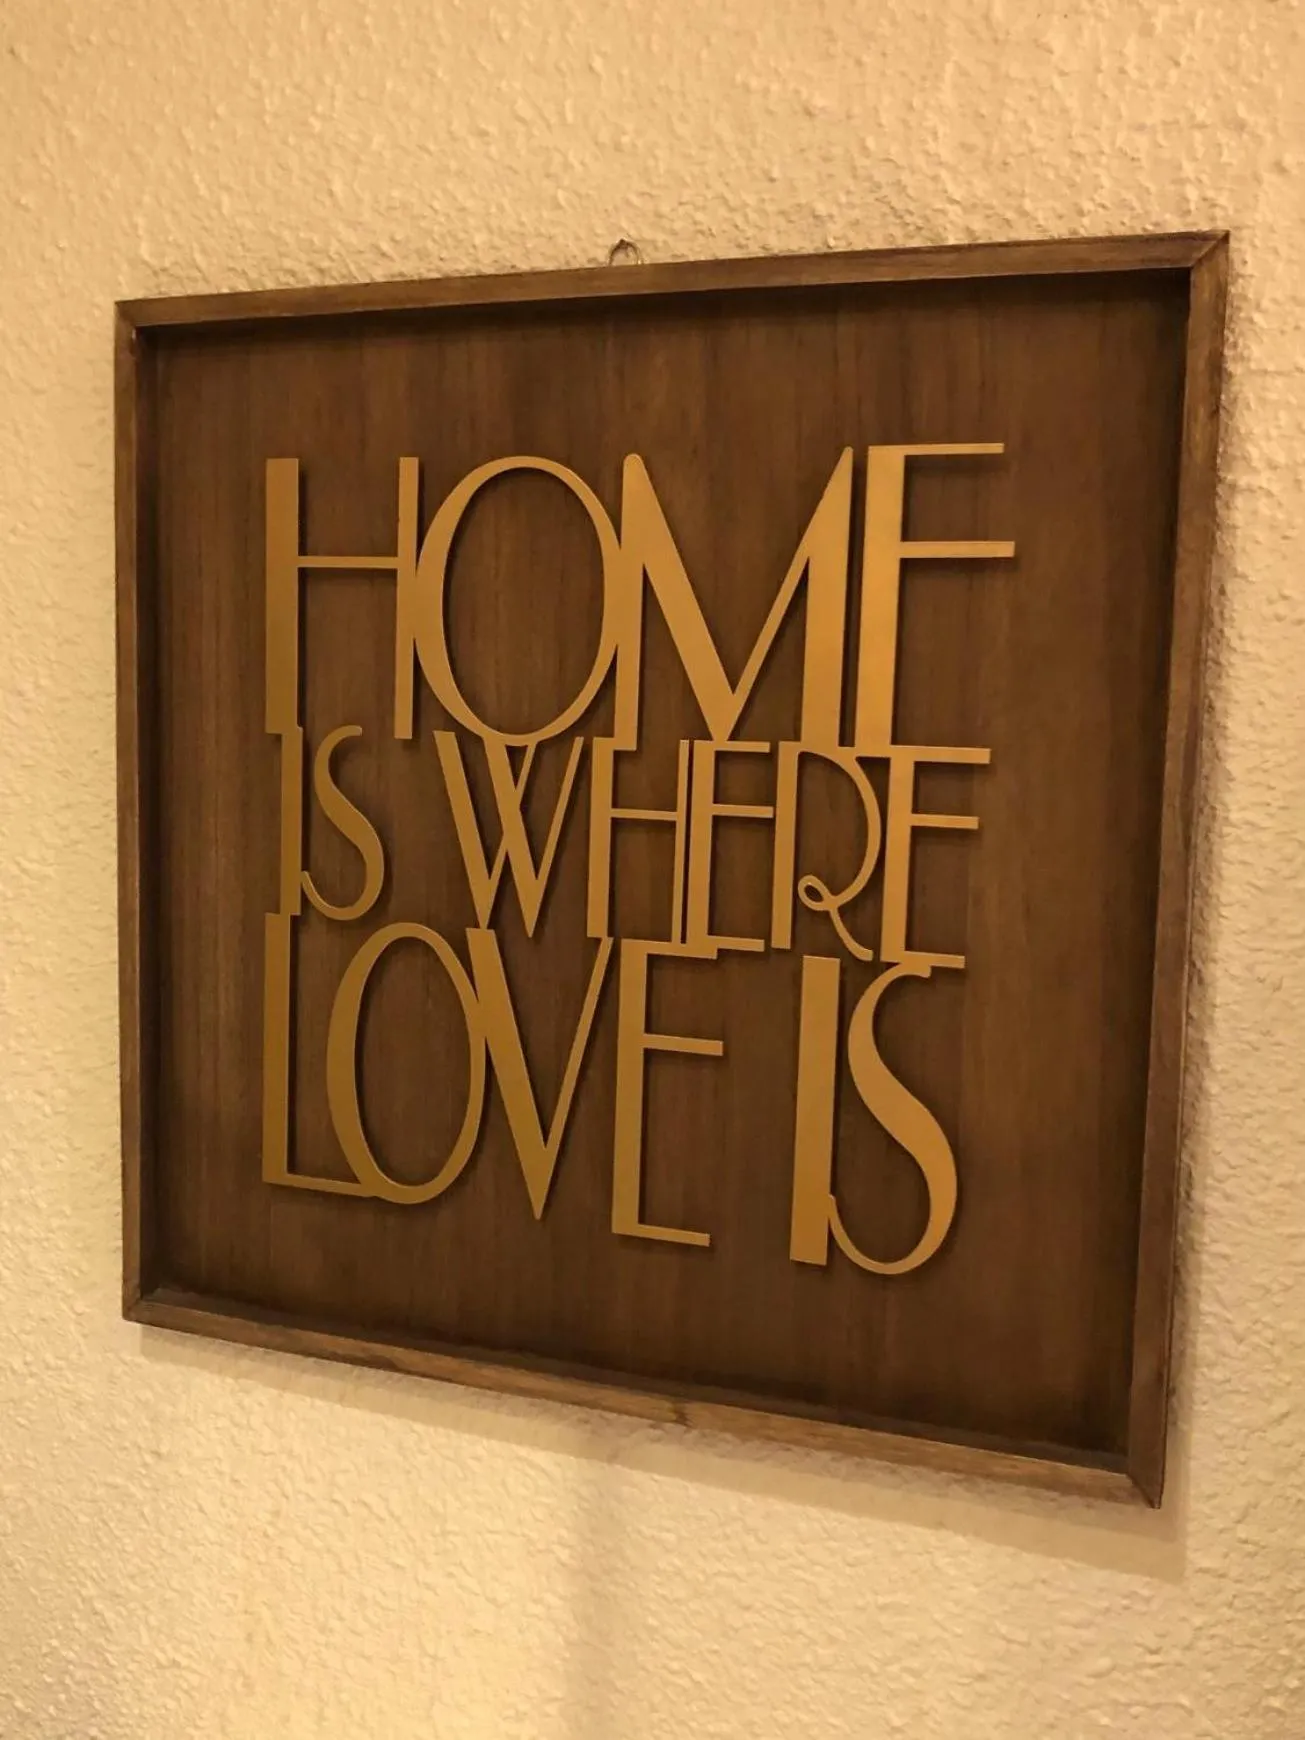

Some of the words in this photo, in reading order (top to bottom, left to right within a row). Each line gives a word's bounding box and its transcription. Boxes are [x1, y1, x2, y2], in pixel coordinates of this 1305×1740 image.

[264, 444, 1016, 755] HOME
[278, 724, 384, 921] IS
[433, 730, 991, 969] WHERE
[262, 913, 724, 1247] LOVE
[789, 955, 958, 1276] IS
